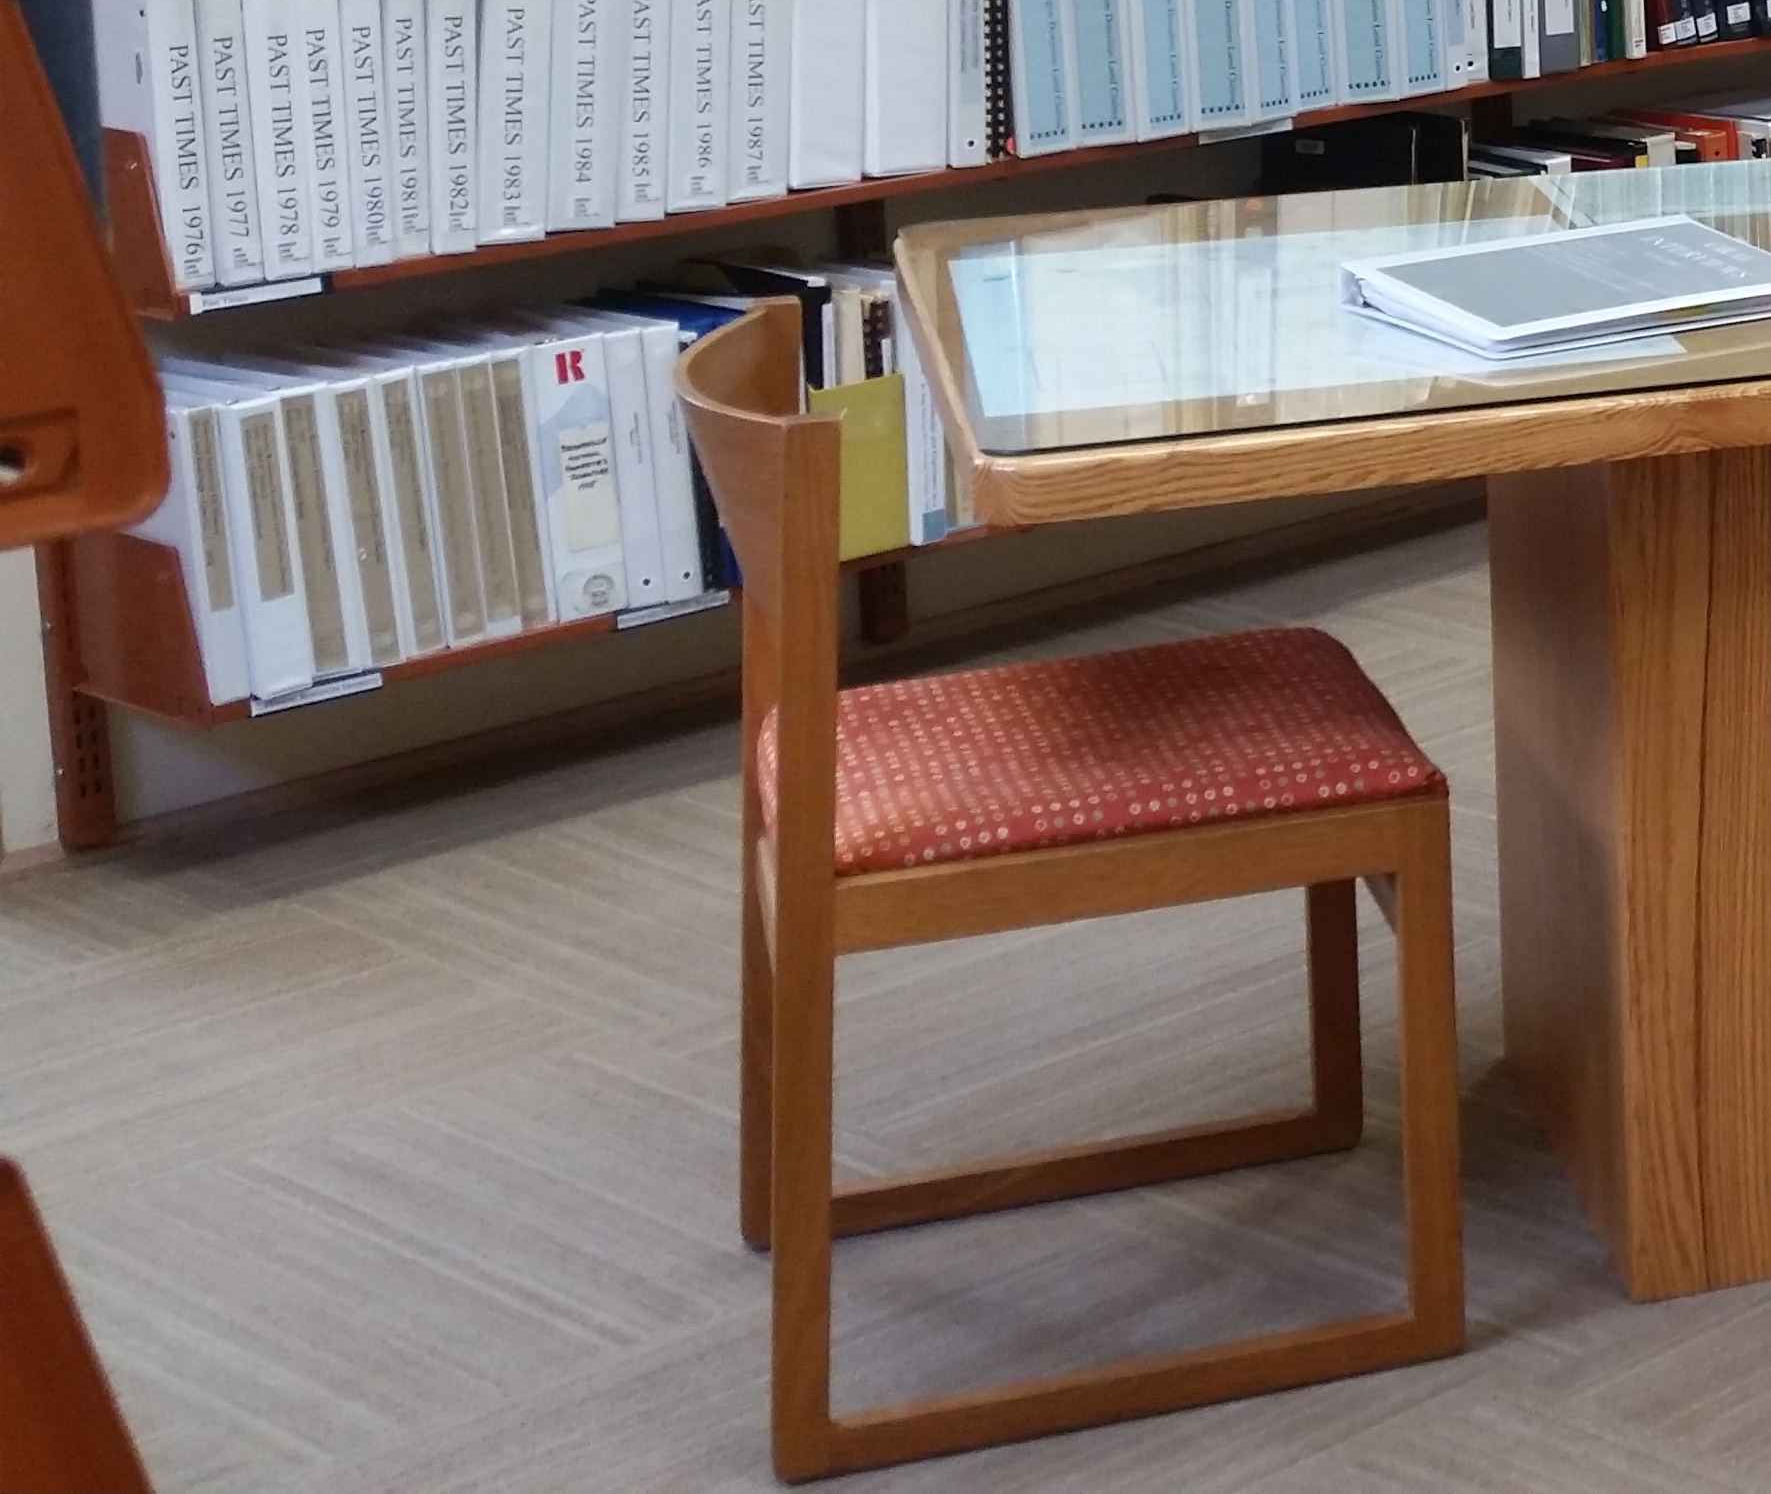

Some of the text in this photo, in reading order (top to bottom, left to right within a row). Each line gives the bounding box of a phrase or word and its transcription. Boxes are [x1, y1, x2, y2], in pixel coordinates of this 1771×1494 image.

[213, 36, 249, 238] PAST TIMES 1977
[267, 33, 299, 236] PAST TIMES 1978
[305, 28, 340, 230] PAST TIMES 1979
[352, 25, 386, 225] PAST TIMES 1980
[395, 18, 419, 214] PAST TIMES 1981
[444, 16, 469, 210] PAST TIMES 1982
[503, 8, 525, 202] PAST TIMES 1983
[576, 56, 595, 129] TIMES
[631, 51, 651, 124] TIMES
[696, 44, 713, 115] TIMES
[746, 116, 764, 163] 1987
[747, 38, 765, 109] TIMES
[169, 44, 204, 257] PAST TIMES 1976
[574, 136, 593, 184] 1984
[631, 131, 650, 177] 1985
[696, 122, 713, 169] 1986
